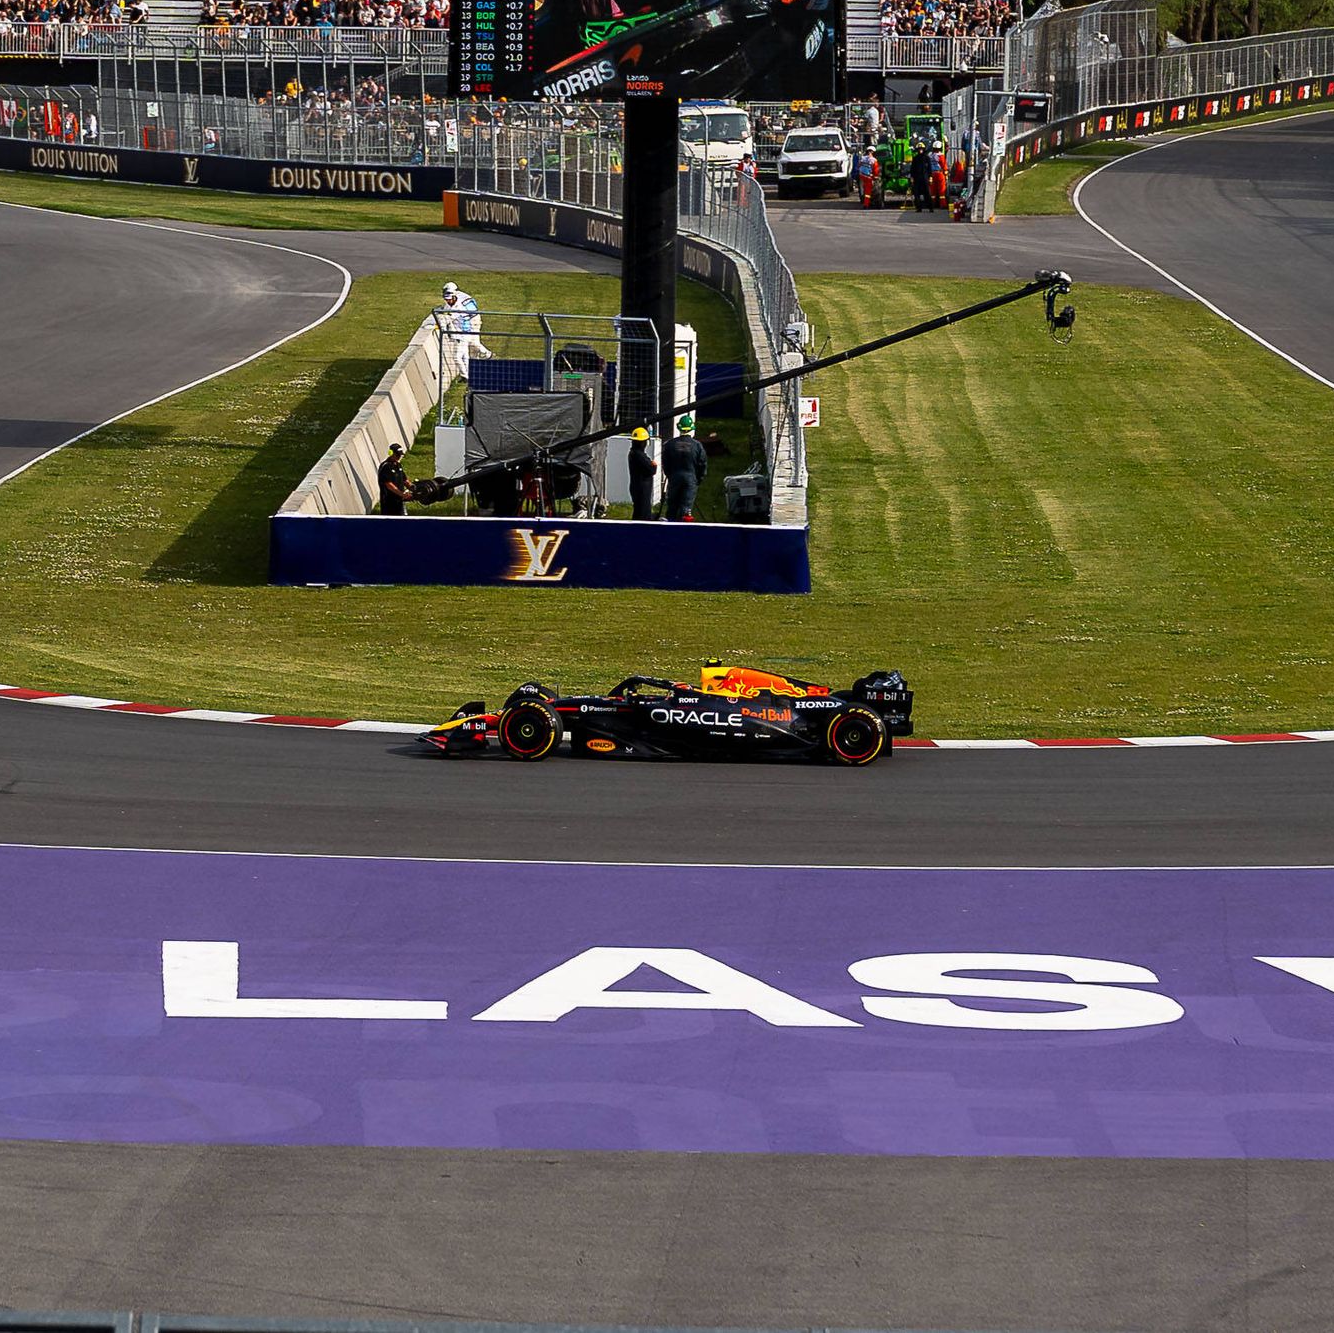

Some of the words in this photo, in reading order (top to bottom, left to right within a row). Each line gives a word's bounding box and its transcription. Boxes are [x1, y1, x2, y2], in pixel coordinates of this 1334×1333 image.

[476, 1, 496, 10] GAS
[506, 1, 523, 10] +0.7
[476, 12, 496, 20] BOR
[506, 12, 523, 20] +0.7
[476, 22, 495, 30] HUL
[506, 22, 523, 31] +0.7
[506, 33, 523, 41] +0.8
[475, 43, 495, 51] BEA
[506, 43, 523, 51] +0.9
[475, 53, 495, 61] OCO
[505, 53, 523, 62] +1.0
[475, 63, 494, 71] COL
[505, 63, 523, 72] +1.7
[475, 73, 494, 81] STR
[543, 60, 616, 97] NORRIS
[627, 82, 664, 90] NORRIS
[32, 147, 65, 170] LOUIS
[68, 151, 118, 174] VUITTON
[271, 166, 321, 190] LOUIS
[325, 169, 412, 194] VUITTON
[466, 200, 488, 223] LOUIS
[490, 202, 520, 227] VUITTON
[587, 218, 606, 243] LOUIS
[607, 223, 623, 248] VUIT
[867, 691, 897, 701] Mobil
[651, 709, 743, 726] ORACLE
[741, 708, 766, 719] Red
[768, 708, 792, 722] Bull
[462, 722, 487, 731] Mobil
[593, 741, 613, 749] RAUCH
[162, 940, 1185, 1031] LAS
